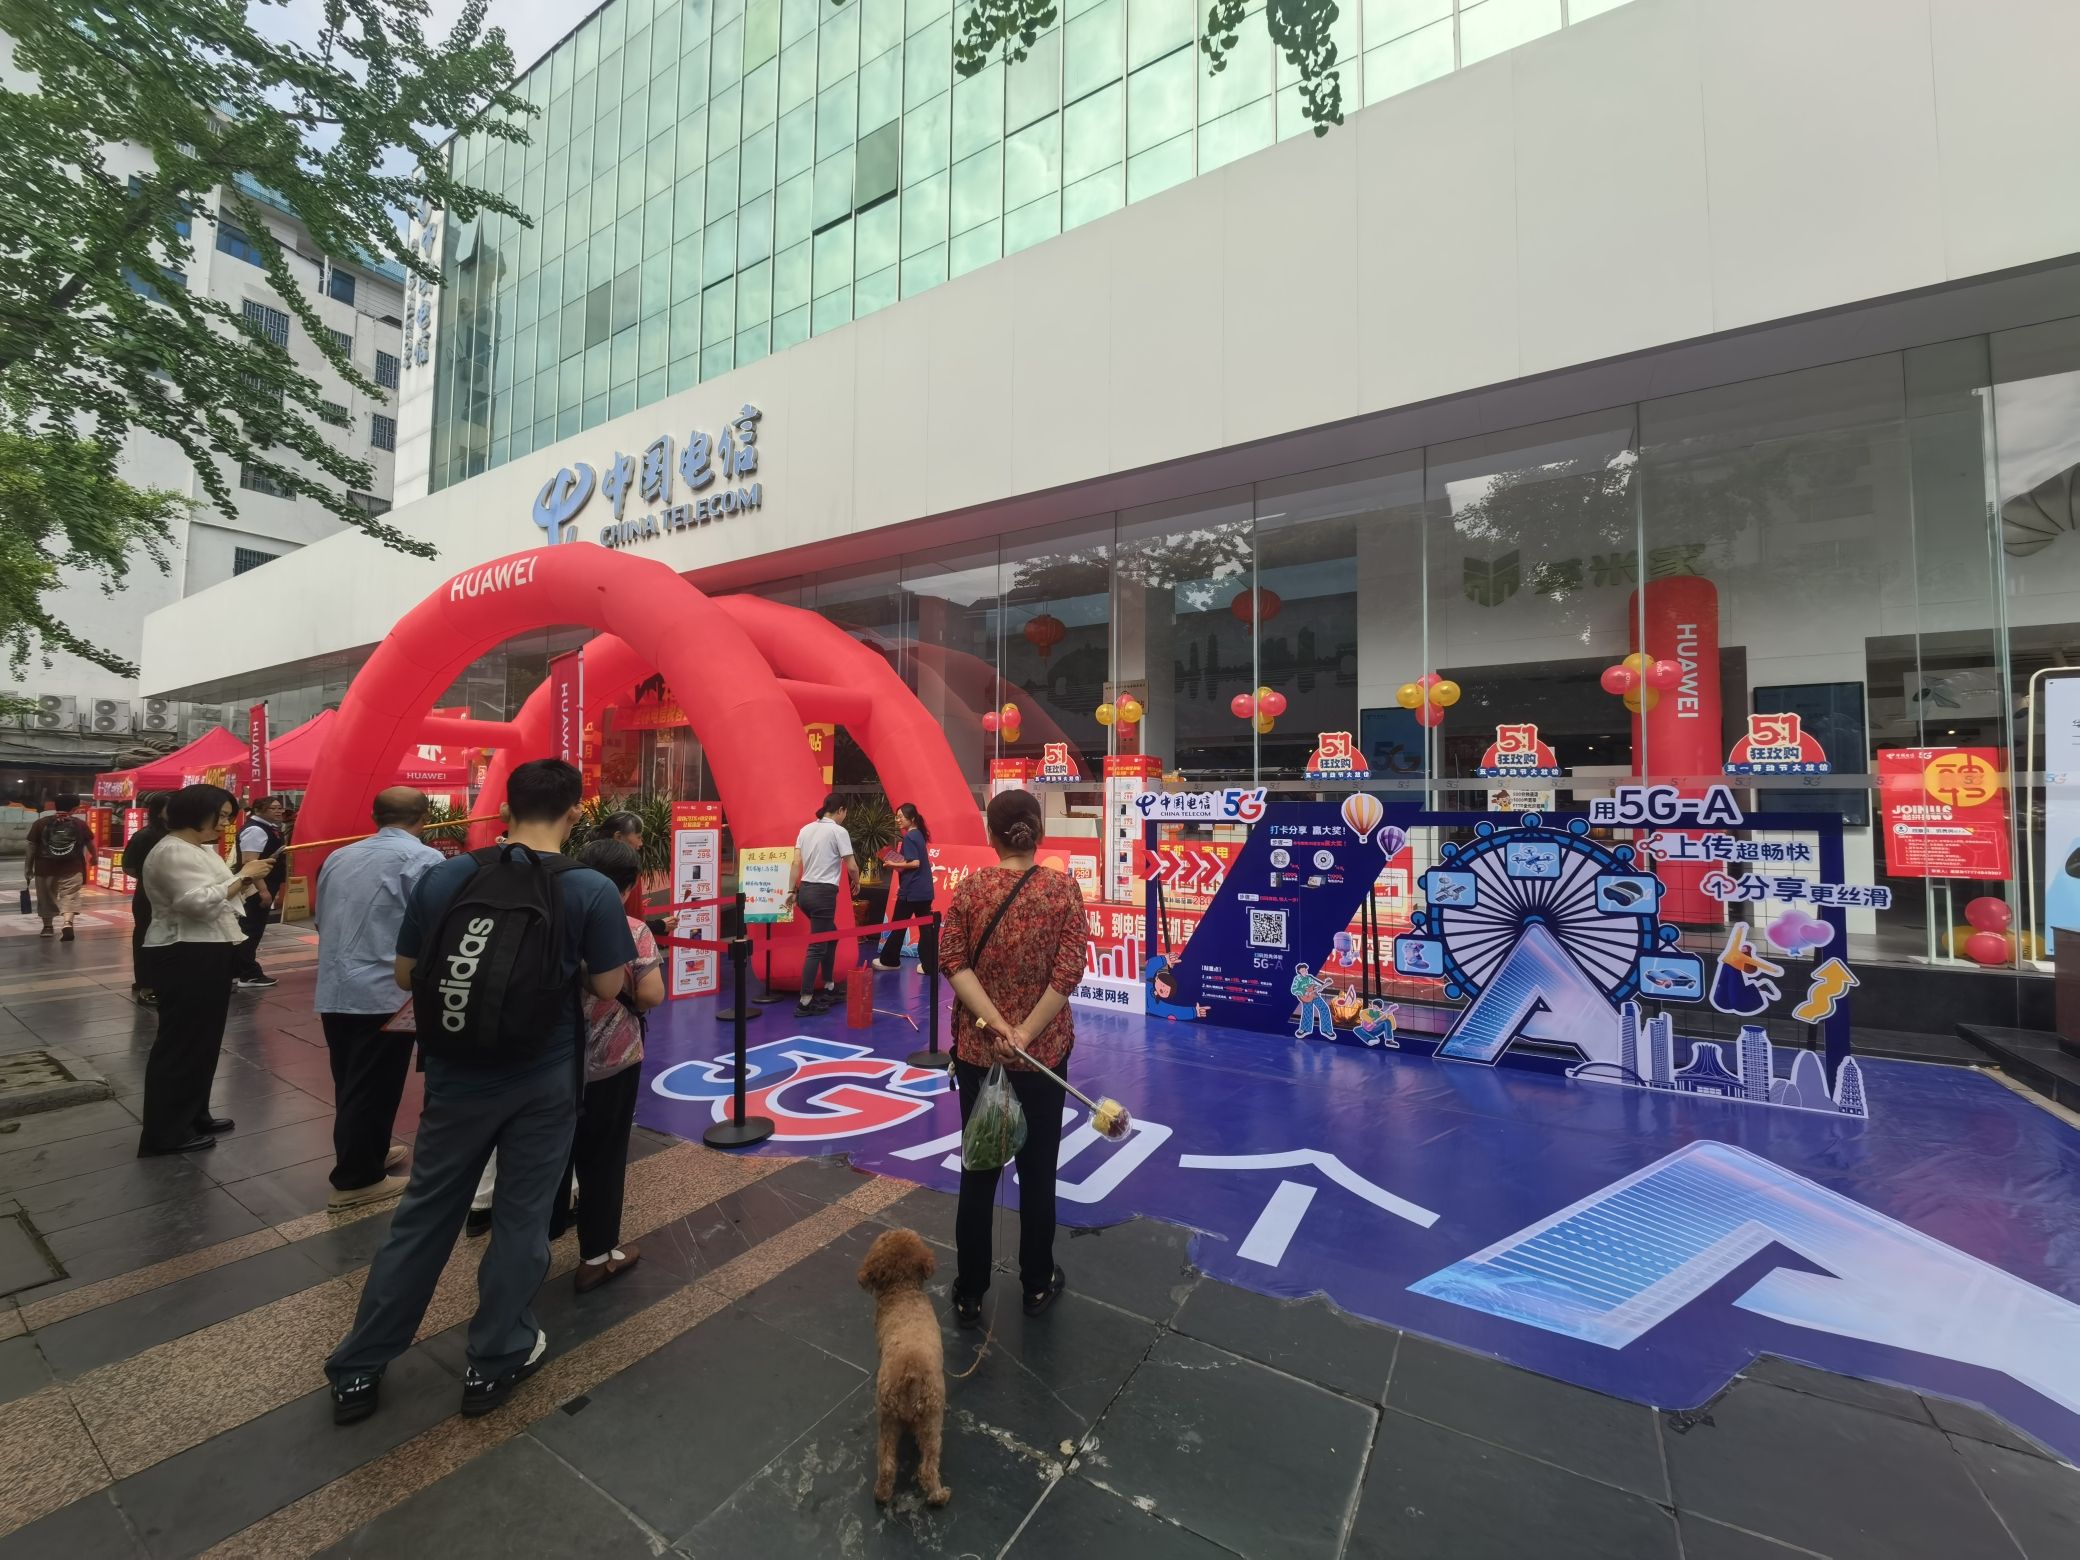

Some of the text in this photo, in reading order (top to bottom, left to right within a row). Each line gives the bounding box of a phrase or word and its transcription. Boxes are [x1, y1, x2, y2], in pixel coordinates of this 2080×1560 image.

[602, 403, 763, 520] 中国电信
[600, 482, 763, 547] CHINA TELECOM
[451, 556, 538, 601] HUAWEI
[1676, 624, 1699, 718] HUAWEI
[561, 682, 569, 761] HUAWE
[1752, 714, 1798, 746] 51
[251, 721, 261, 782] HUAWEI
[1320, 733, 1350, 758] 51
[1500, 725, 1536, 753] 51
[1750, 747, 1799, 760] 狂欢购
[1045, 744, 1067, 764] 51
[1498, 753, 1537, 765] 狂欢购
[406, 772, 446, 780] HUAWEI
[1160, 797, 1211, 811] 中国电信
[1224, 791, 1264, 820] 5G
[1594, 789, 1738, 821] 用5G-A
[1270, 825, 1307, 835] 打卡分享
[1669, 835, 1811, 861] 上传超畅快
[1738, 876, 1888, 907] 分享更丝滑
[438, 917, 494, 1032] adidas
[1253, 958, 1284, 970] 5G-A
